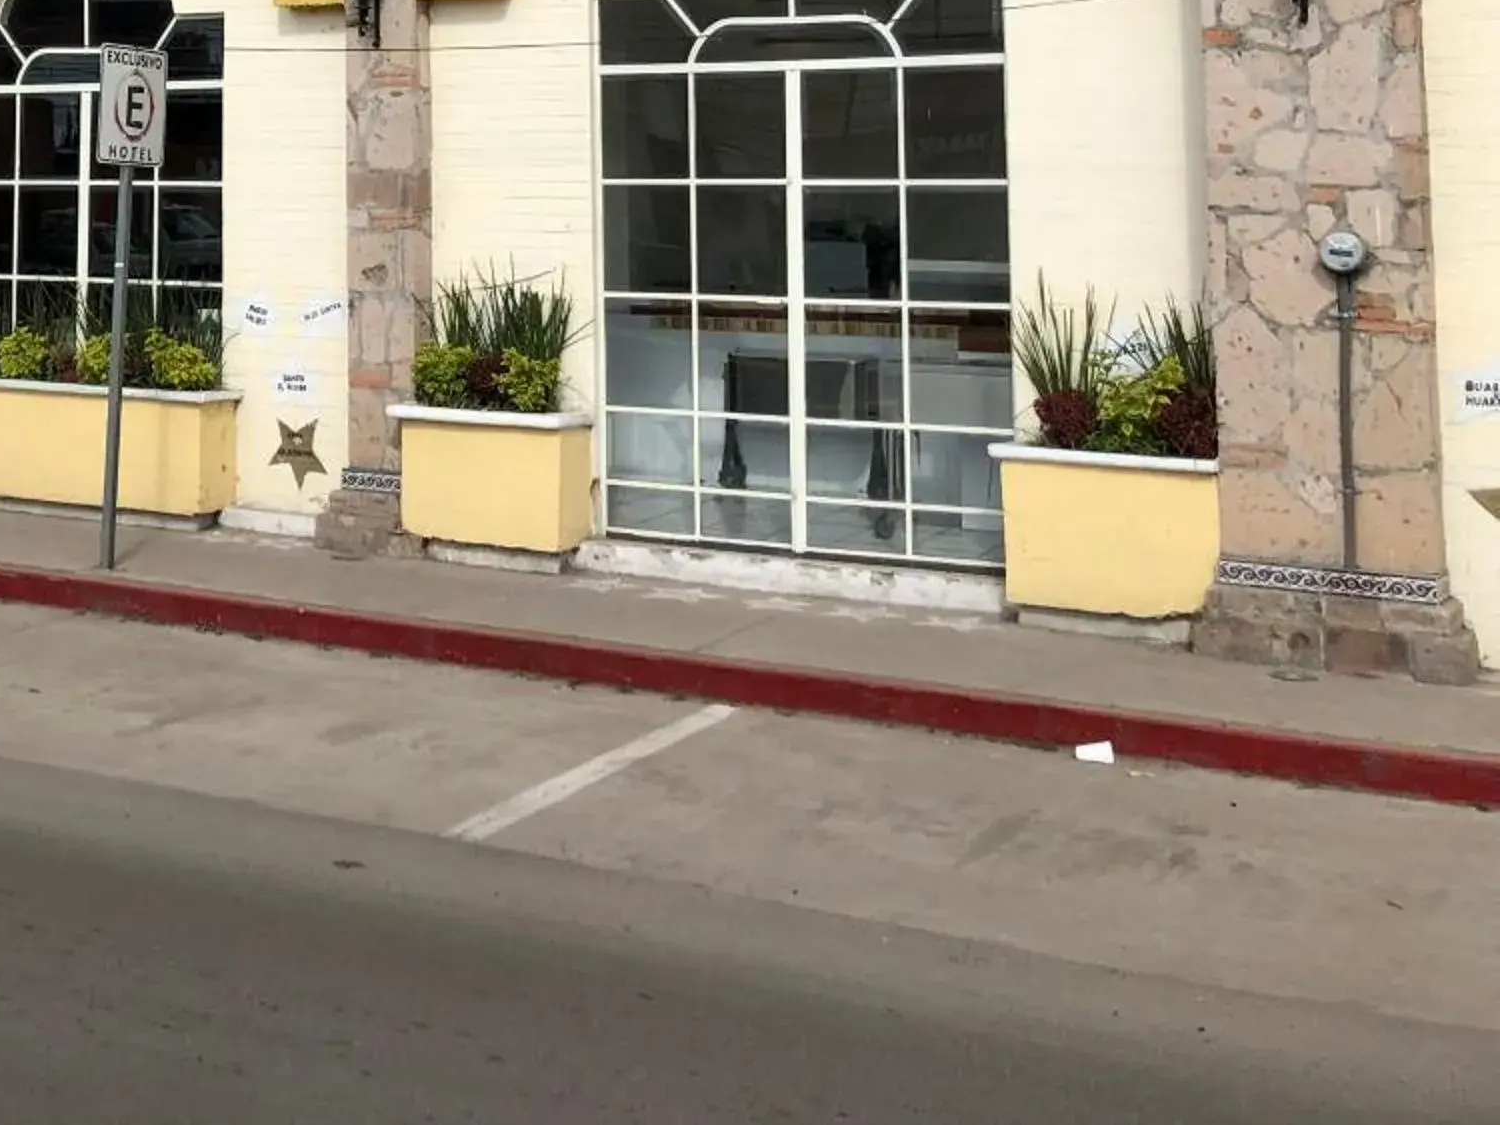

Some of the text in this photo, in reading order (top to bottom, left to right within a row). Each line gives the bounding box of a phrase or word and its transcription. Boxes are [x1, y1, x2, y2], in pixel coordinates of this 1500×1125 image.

[107, 50, 162, 70] EXCLUSIVO
[125, 85, 145, 129] E
[108, 144, 152, 162] HOTEL
